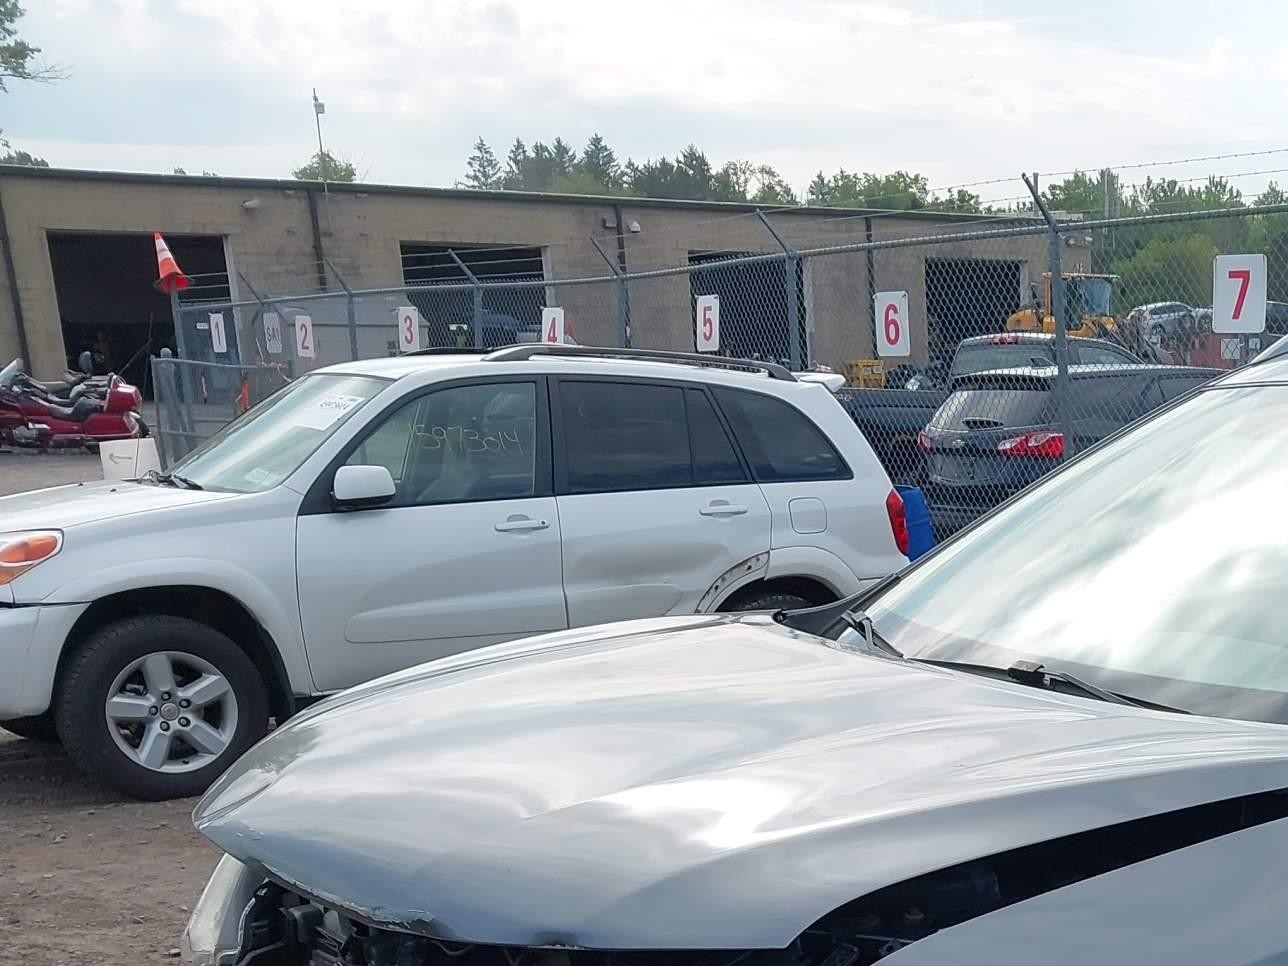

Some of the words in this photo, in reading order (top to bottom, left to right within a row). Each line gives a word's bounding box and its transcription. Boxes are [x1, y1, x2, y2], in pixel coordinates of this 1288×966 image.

[1227, 269, 1251, 320] 7
[214, 321, 222, 346] 1
[300, 323, 309, 350] 2
[404, 315, 414, 344] 3
[547, 316, 557, 343] 4
[703, 306, 713, 342] 5
[884, 303, 901, 346] 6
